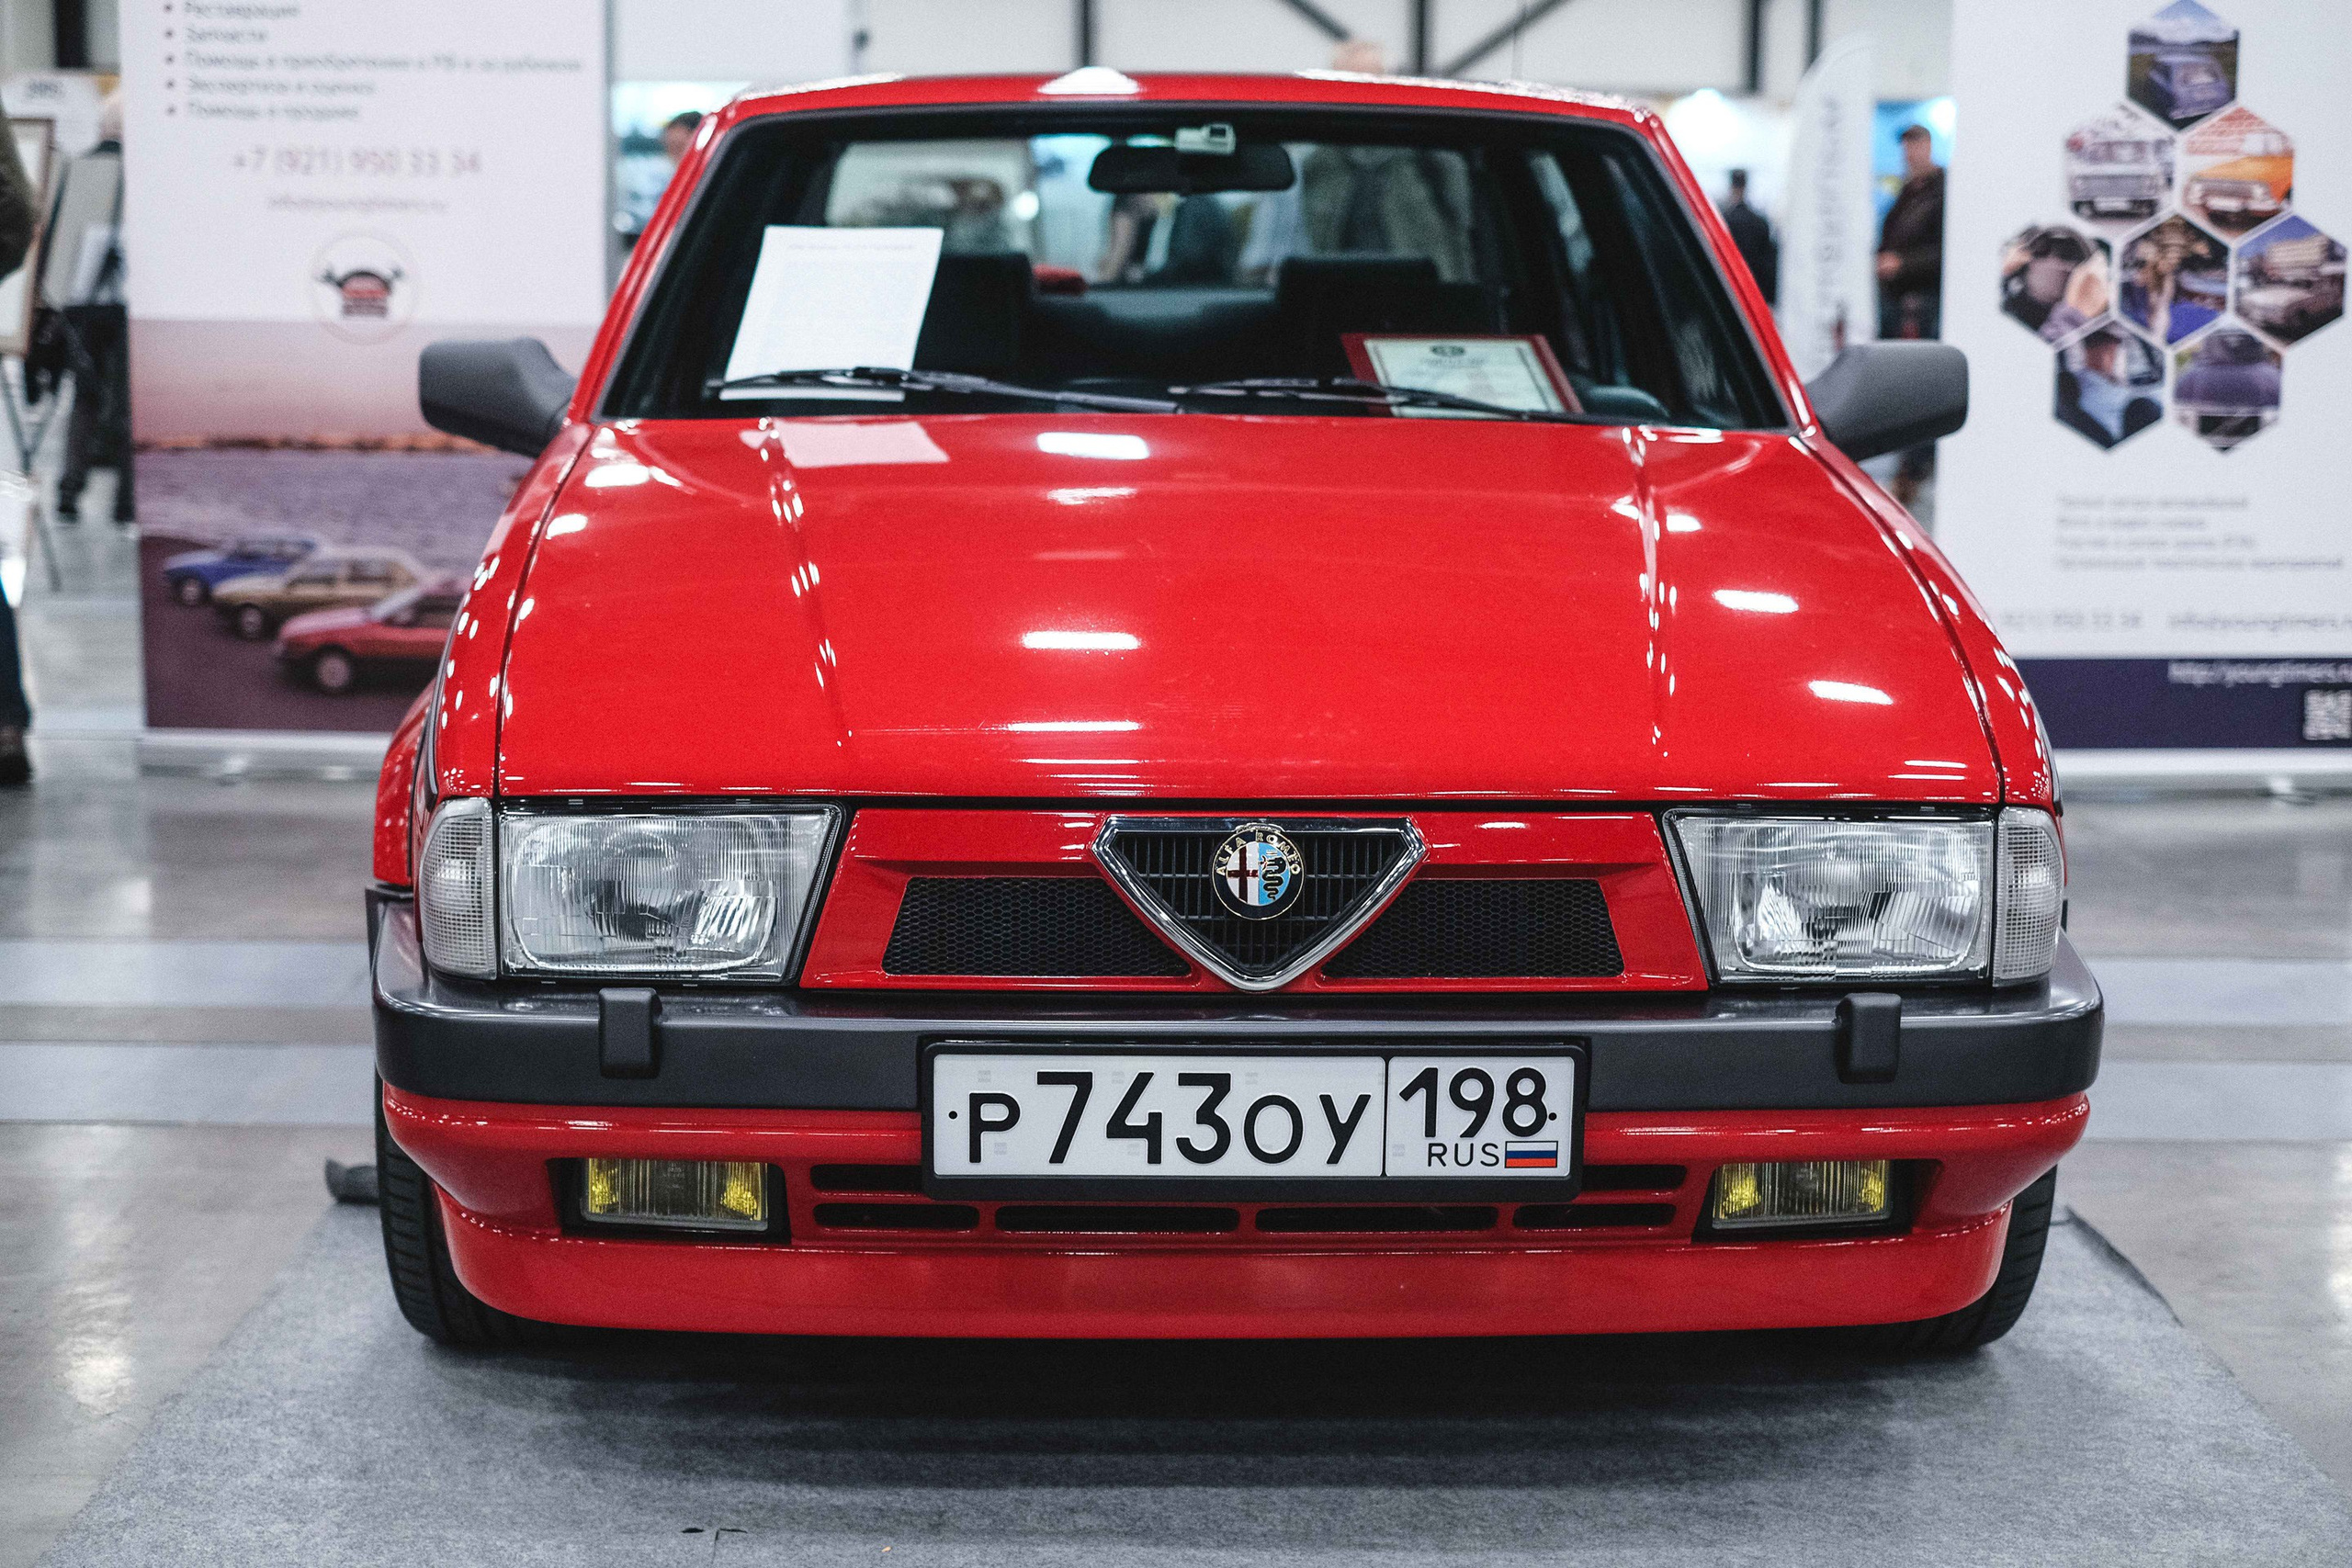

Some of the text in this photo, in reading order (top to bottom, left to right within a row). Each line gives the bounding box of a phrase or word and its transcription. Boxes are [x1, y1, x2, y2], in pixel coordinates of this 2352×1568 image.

[1216, 829, 1302, 876] ALFA ROMEO
[1397, 1066, 1547, 1139] 198
[1427, 1141, 1500, 1168] RUS
